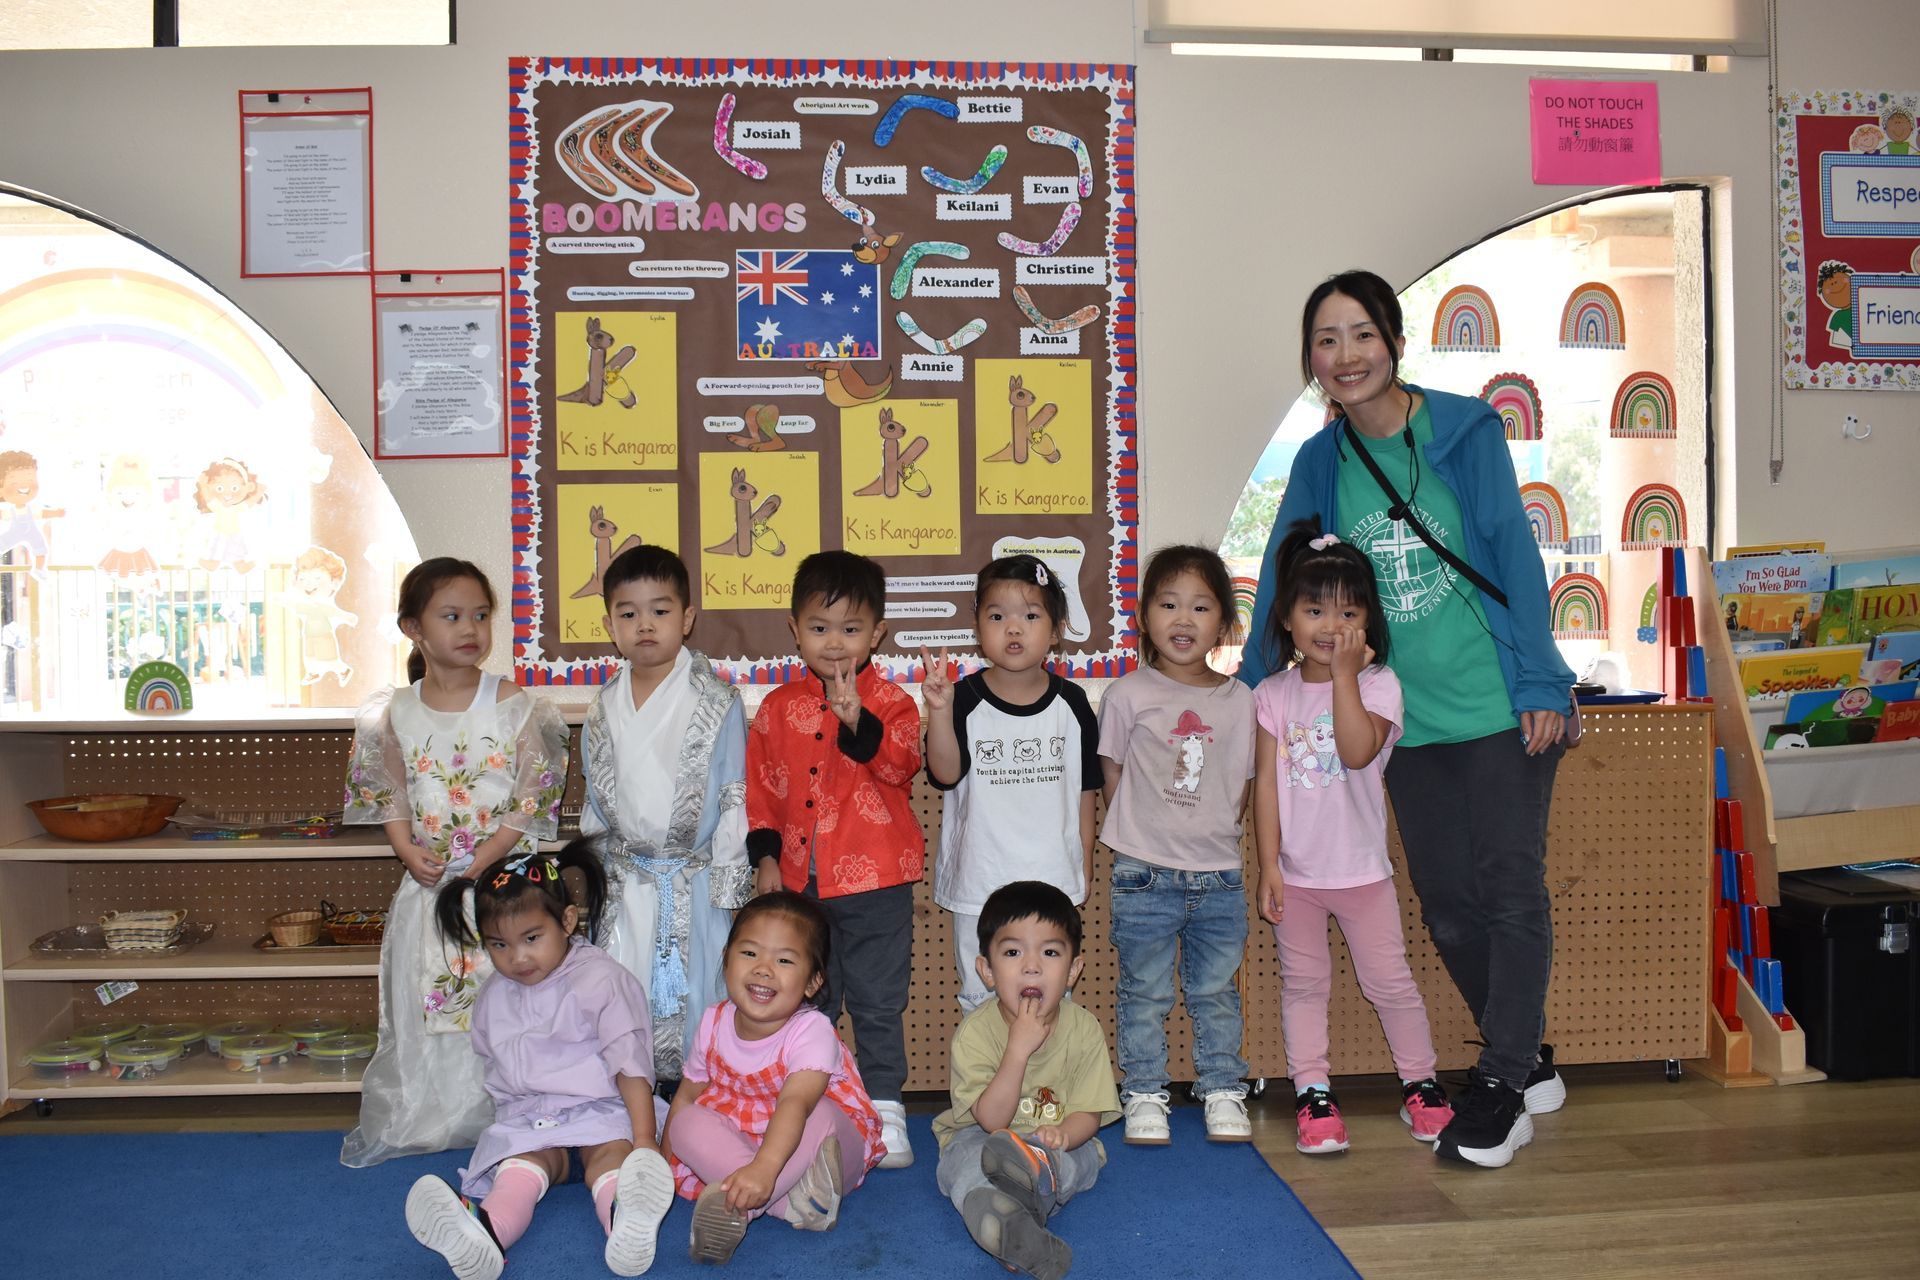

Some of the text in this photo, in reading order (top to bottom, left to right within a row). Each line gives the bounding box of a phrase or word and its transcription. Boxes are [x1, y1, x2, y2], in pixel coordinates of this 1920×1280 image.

[800, 102, 836, 110] Aboriginal
[968, 103, 1011, 114] Bettie
[1545, 97, 1643, 110] DO NOT TOUCH
[1556, 116, 1634, 130] THE SHADES
[743, 128, 791, 140] Josiah
[856, 174, 896, 186] Lydia
[1033, 183, 1069, 194] Evan
[947, 200, 999, 212] Keilani
[543, 201, 807, 233] BOOMERANGS
[1026, 263, 1095, 275] Christine
[919, 276, 994, 288] Alexander
[1029, 333, 1068, 344] Anna
[910, 360, 954, 372] Annie
[560, 431, 579, 455] K
[584, 436, 597, 457] is
[979, 485, 1089, 513] K is Kangaroo.
[1349, 510, 1384, 541] NITED
[846, 516, 957, 549] K is Kangaroo.
[1746, 569, 1760, 581] I'm
[1761, 567, 1775, 579] So
[705, 572, 721, 596] K
[726, 581, 737, 596] is
[1738, 579, 1807, 593] You Were Born
[1421, 573, 1458, 617] CENTER
[565, 619, 601, 639] K is
[976, 768, 998, 776] Youth
[1008, 767, 1035, 776] capital
[990, 777, 1020, 785] achieve
[1022, 776, 1035, 784] the
[1165, 797, 1196, 808] octopus
